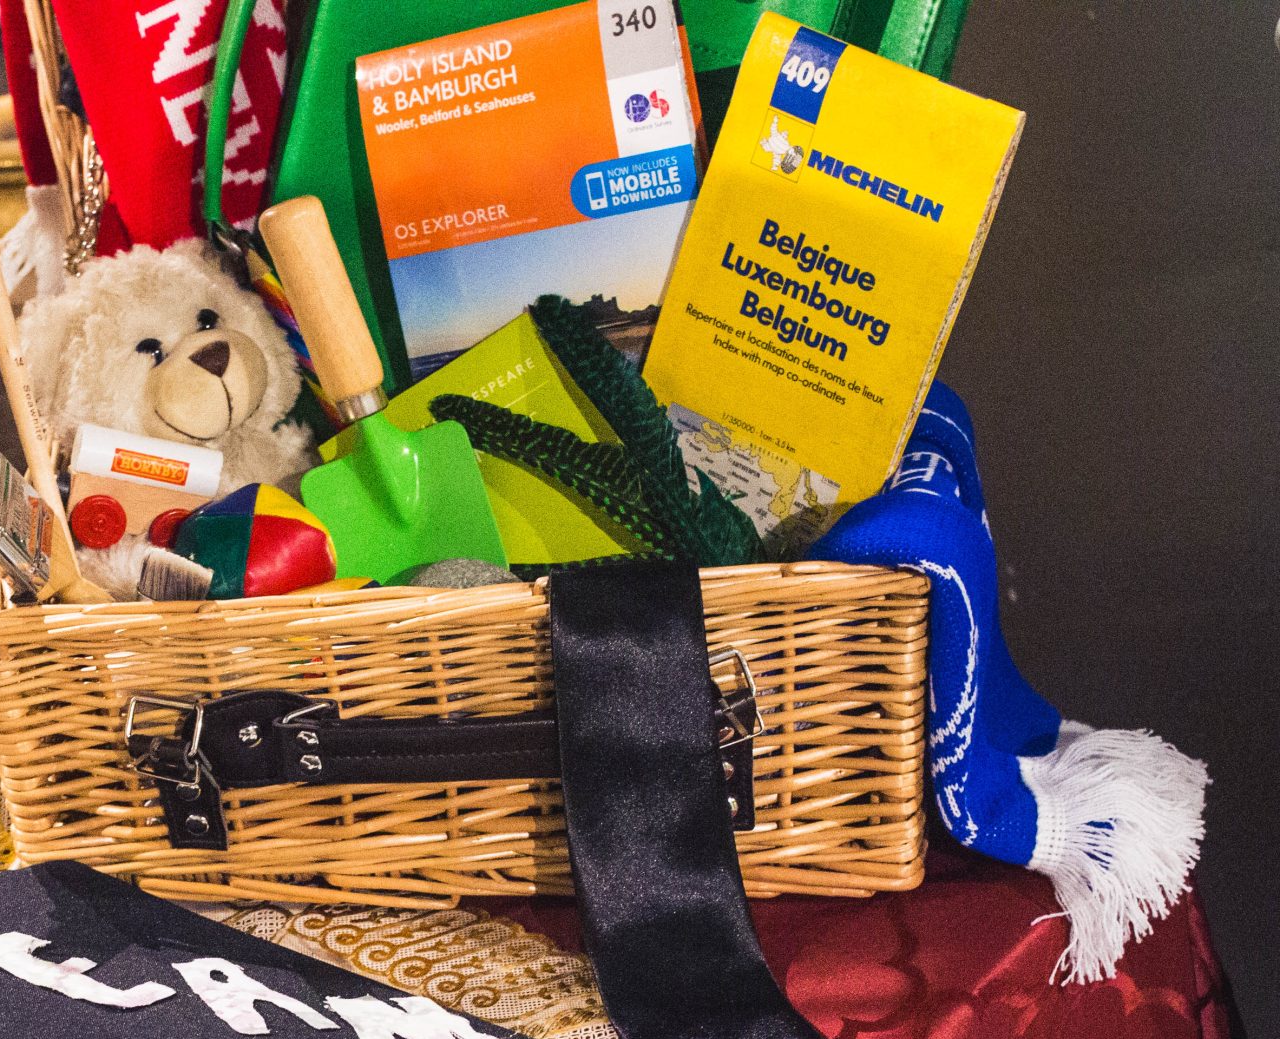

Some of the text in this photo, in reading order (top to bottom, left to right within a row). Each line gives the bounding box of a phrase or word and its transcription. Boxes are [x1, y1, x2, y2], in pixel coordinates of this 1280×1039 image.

[611, 5, 657, 37] 340
[369, 38, 512, 91] HOLY ISLAND
[780, 54, 831, 94] 409
[372, 65, 518, 116] & BAMBURGH
[375, 91, 537, 136] Wooler, Belford & Seahouses
[607, 155, 678, 179] NOW INCLUDES
[609, 165, 681, 196] MOBILE
[806, 149, 945, 223] MICHELIN
[611, 183, 682, 207] DOWNLOAD
[394, 221, 418, 240] OS
[421, 204, 510, 236] EXPLORER
[758, 218, 876, 292] Belgique
[721, 242, 891, 346] Luxembourg
[739, 289, 848, 362] Belgium
[713, 334, 846, 406] Index with map co-ordinates
[735, 329, 746, 340] et
[747, 330, 800, 365] localisation
[802, 356, 819, 374] des
[821, 369, 846, 387] noms
[848, 378, 861, 394] de
[861, 385, 885, 406] lieux
[120, 455, 181, 479] HORNBY
